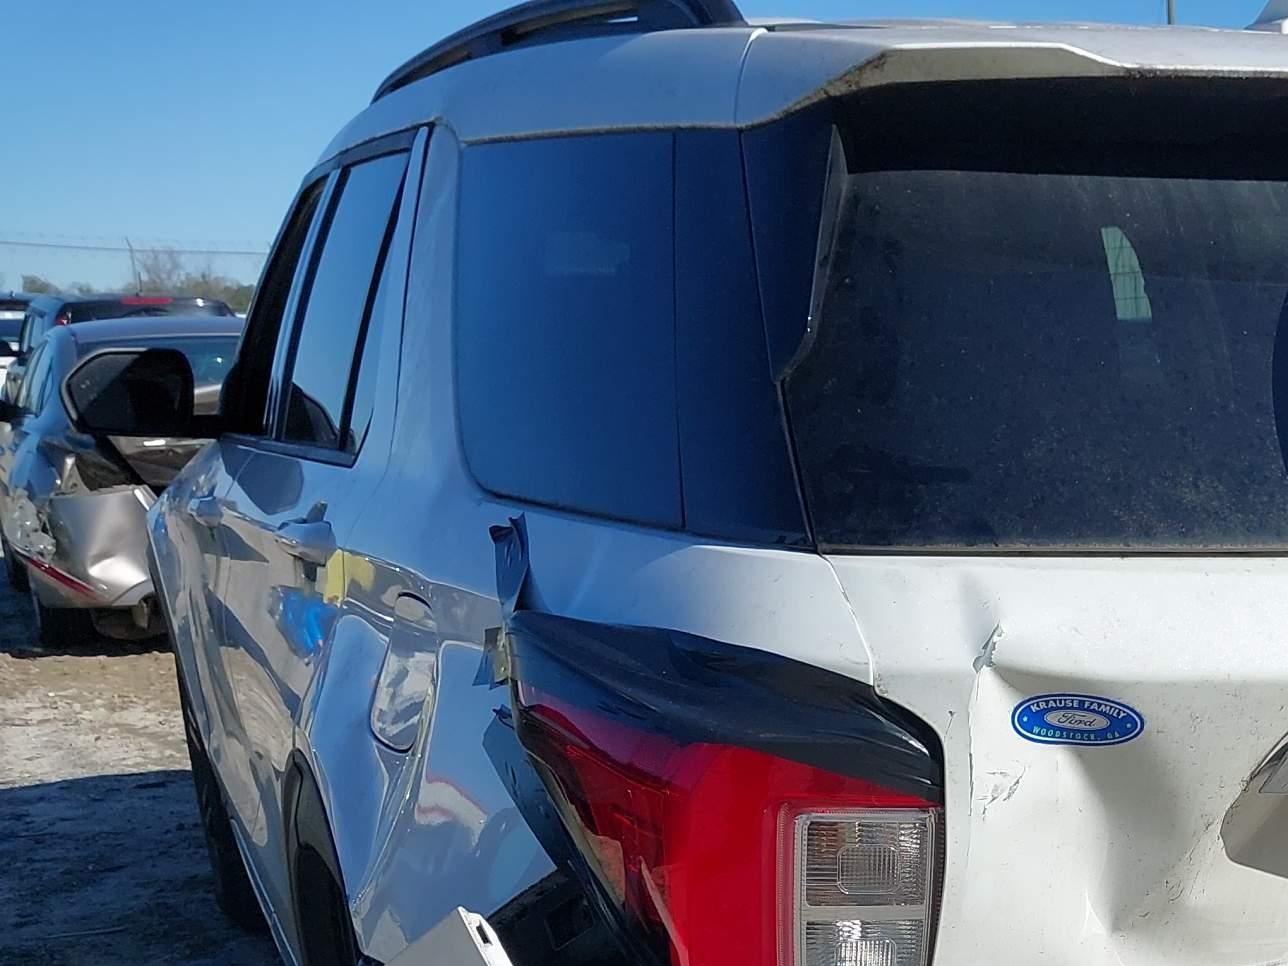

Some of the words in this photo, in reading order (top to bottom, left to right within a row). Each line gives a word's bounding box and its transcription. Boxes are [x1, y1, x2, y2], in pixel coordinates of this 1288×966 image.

[1030, 699, 1079, 713] KRAUSE
[1084, 701, 1127, 719] FAMILY
[1057, 712, 1095, 727] Ford
